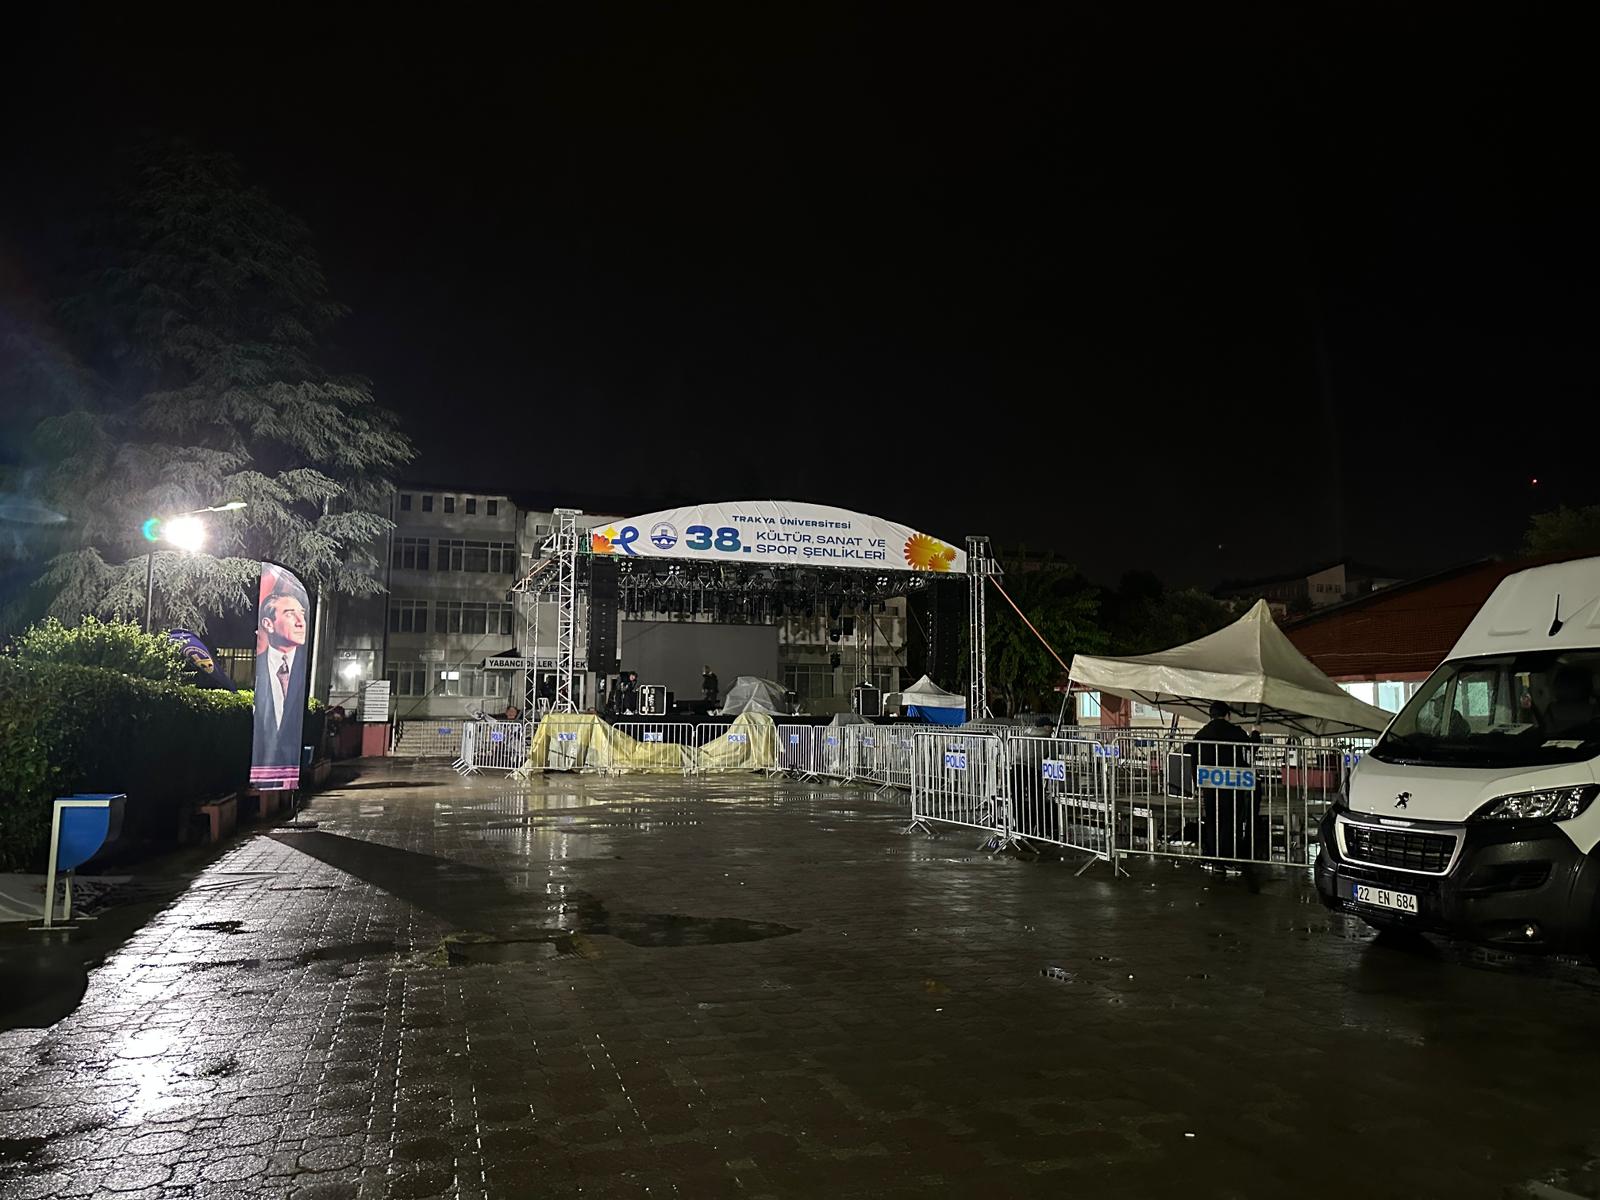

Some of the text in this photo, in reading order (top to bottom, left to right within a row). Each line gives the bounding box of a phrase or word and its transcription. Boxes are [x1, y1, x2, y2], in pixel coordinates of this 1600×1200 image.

[732, 515, 851, 529] TRAKYA ÜNİVERSİTESİ
[686, 525, 752, 553] 38.
[817, 535, 863, 547] SANAT
[868, 538, 886, 548] VE
[756, 544, 886, 560] SPOR ŞENLİKLERİ
[489, 659, 524, 668] YABANCI
[1359, 886, 1415, 910] 22 EN 684
